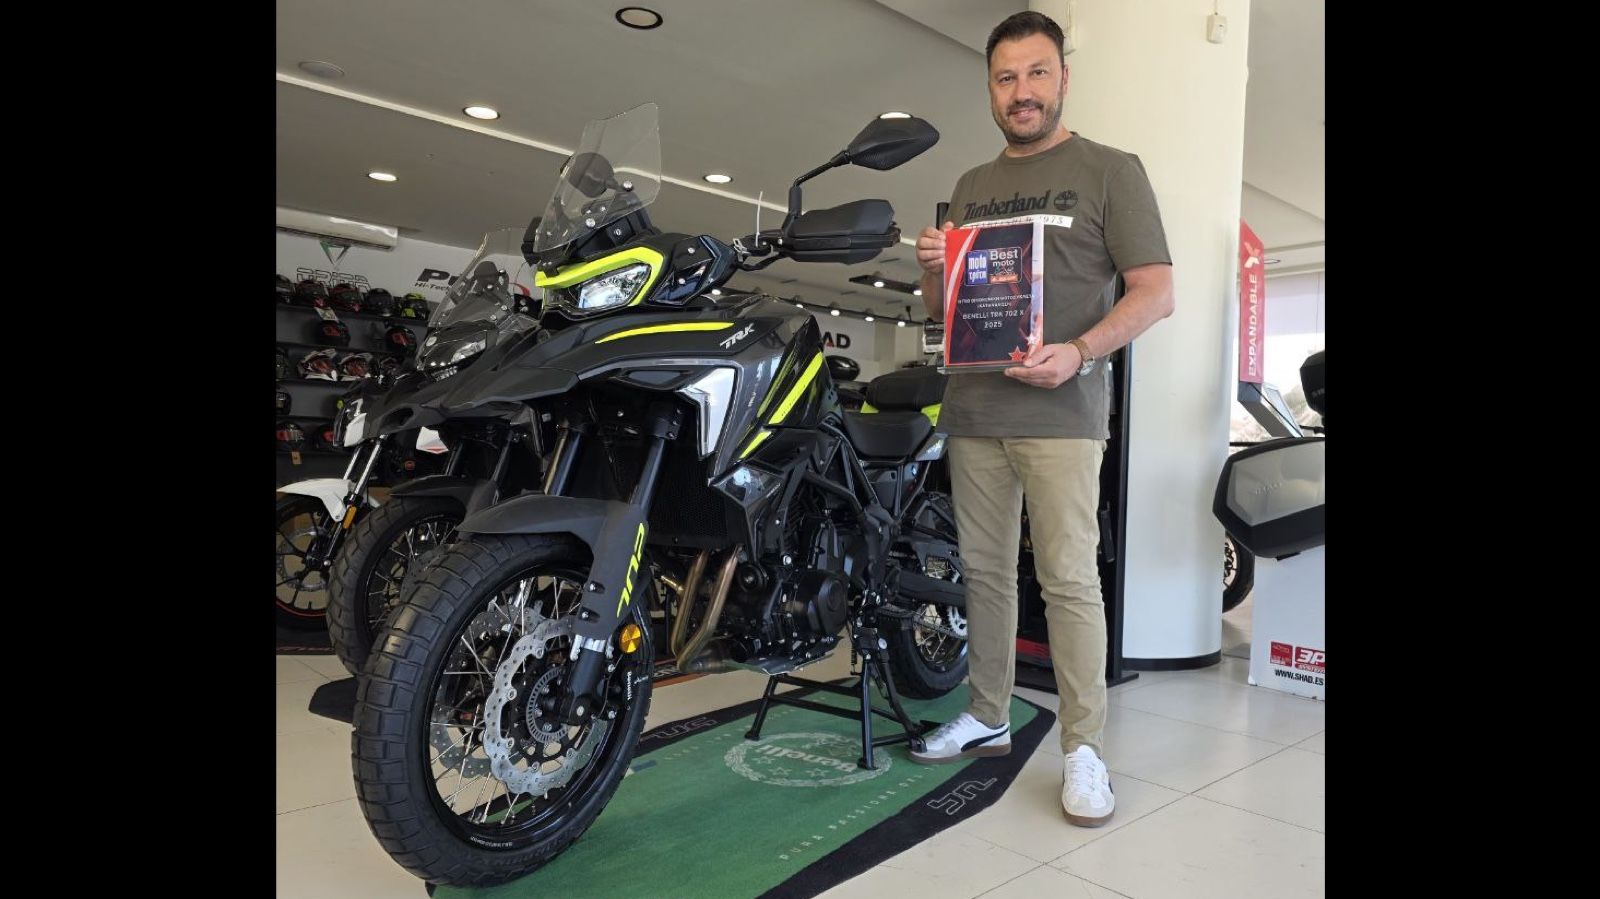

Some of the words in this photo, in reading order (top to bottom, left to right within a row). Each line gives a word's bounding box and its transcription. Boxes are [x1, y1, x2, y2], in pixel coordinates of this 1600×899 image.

[963, 189, 1051, 220] Timberland
[990, 249, 1019, 261] Best
[963, 312, 988, 320] BENELLI
[984, 321, 1003, 329] 2025
[1248, 274, 1258, 377] EXPANDABLE
[720, 322, 755, 349] TRK
[1274, 668, 1324, 686] WWW.SHAD.ES
[753, 744, 859, 773] Benelli
